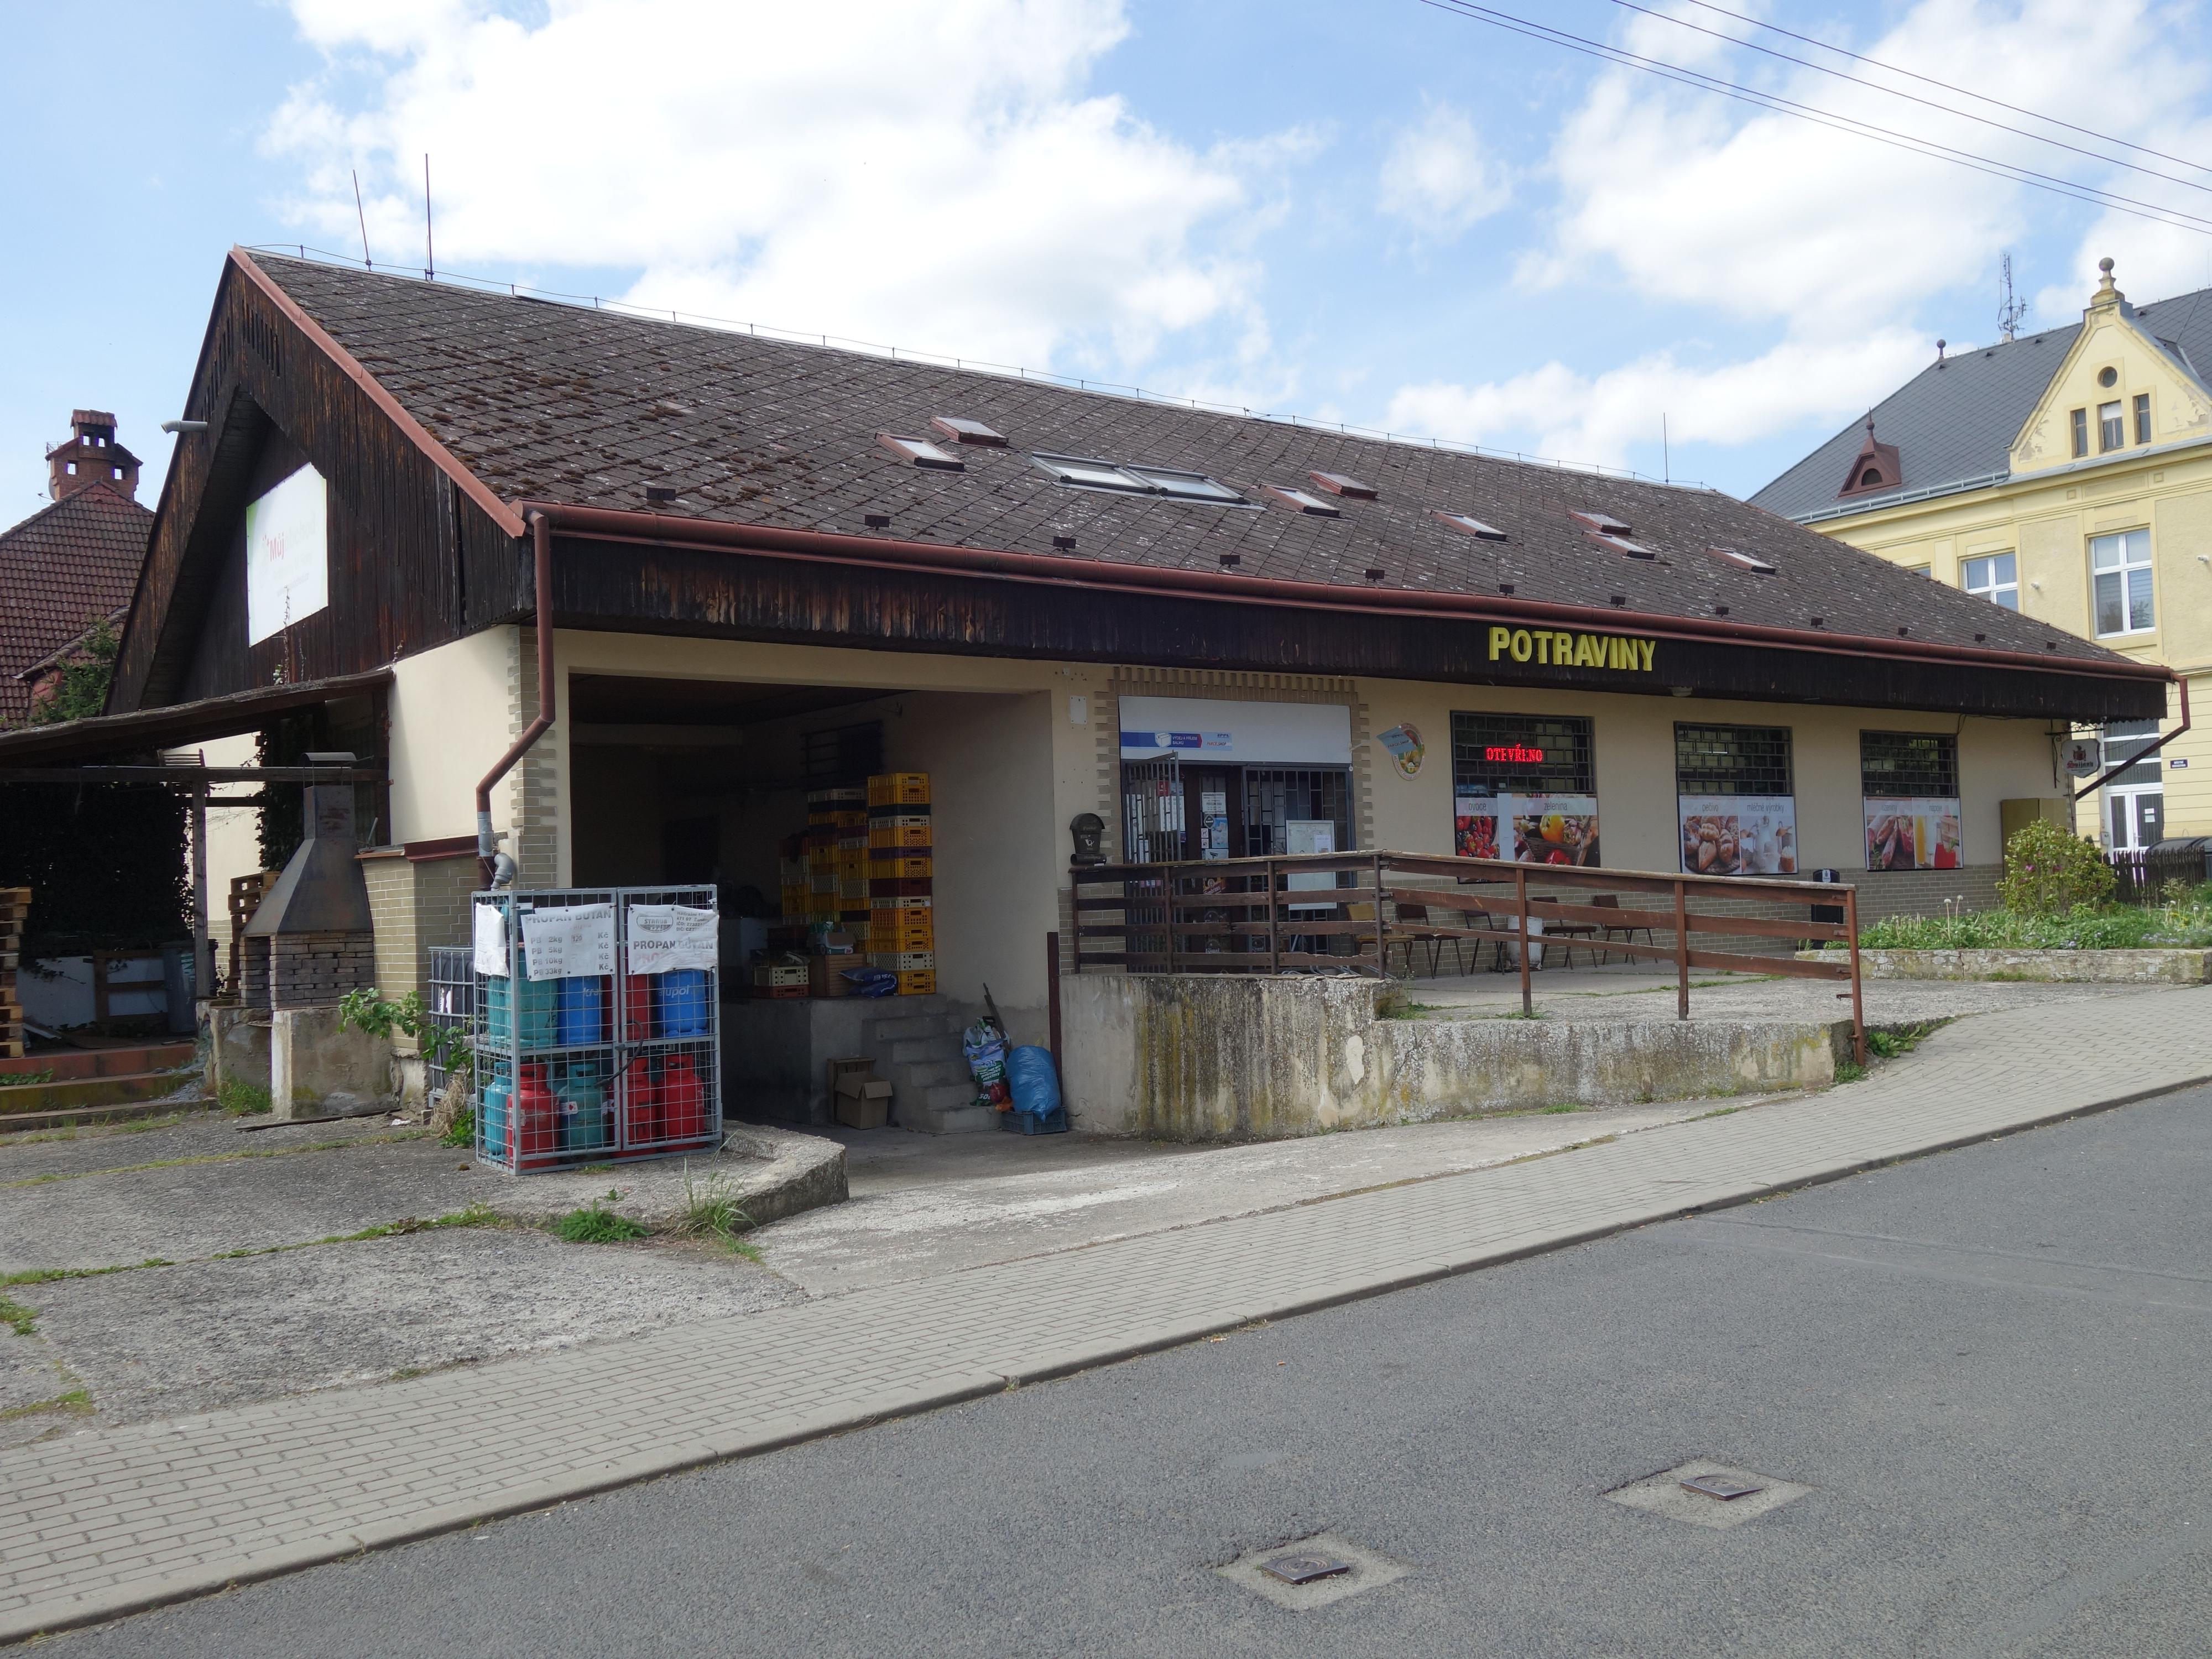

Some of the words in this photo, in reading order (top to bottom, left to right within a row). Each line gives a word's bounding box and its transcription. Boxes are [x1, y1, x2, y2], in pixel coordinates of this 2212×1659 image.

[1489, 627, 1656, 671] POTRAVINY
[1486, 744, 1543, 762] OTEVŘENO
[1469, 802, 1486, 811] ovoce
[1544, 802, 1567, 811] zelenina
[1702, 803, 1719, 813] pečivo
[576, 910, 611, 920] BUTAN
[633, 940, 675, 950] PROPAN
